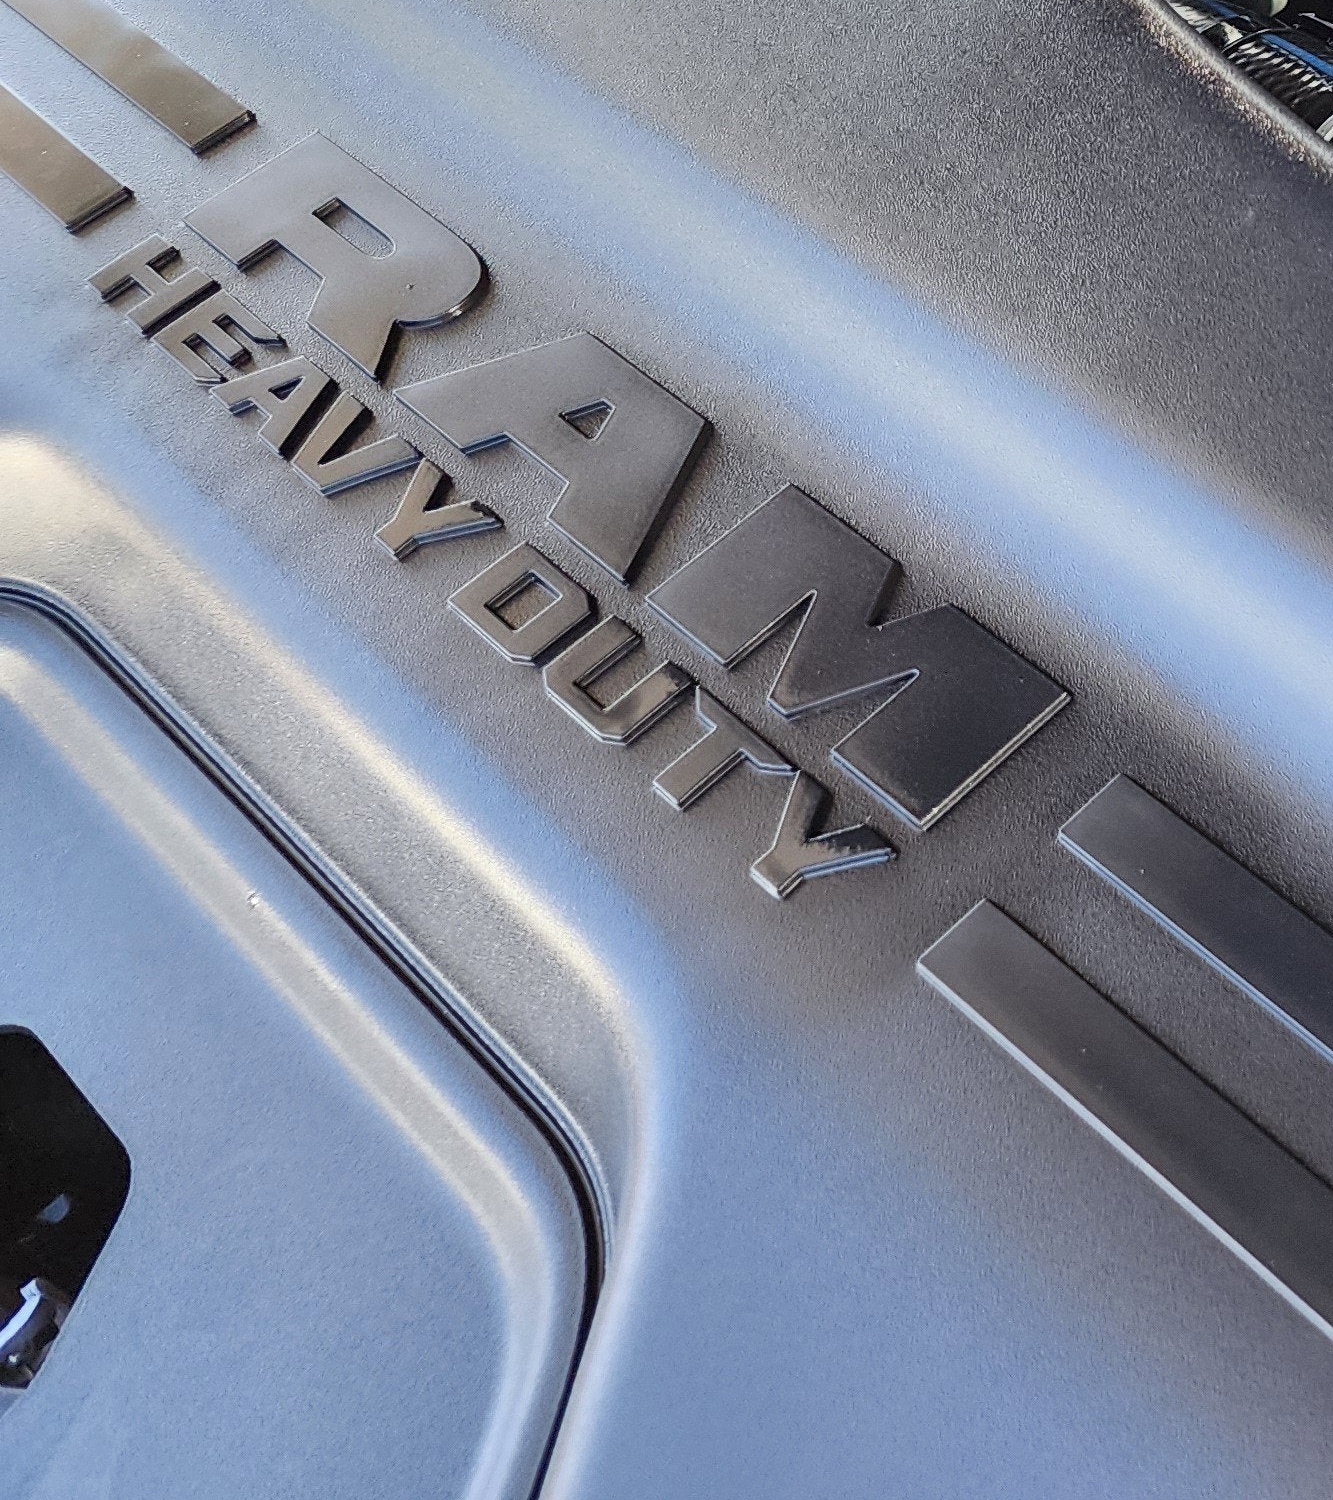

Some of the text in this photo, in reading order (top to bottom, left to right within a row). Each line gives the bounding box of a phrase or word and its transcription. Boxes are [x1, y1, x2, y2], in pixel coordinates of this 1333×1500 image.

[88, 233, 898, 901] HEAVY DUTY
[182, 130, 1072, 831] RAM
